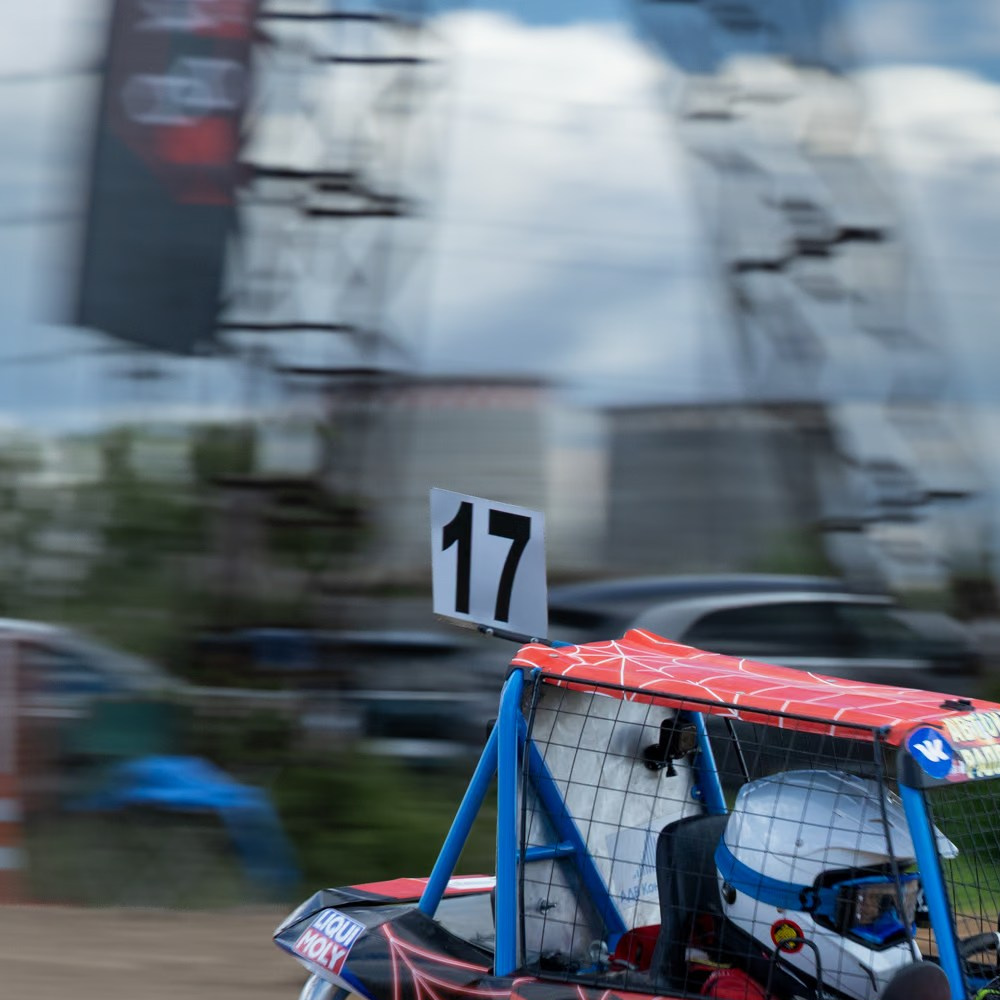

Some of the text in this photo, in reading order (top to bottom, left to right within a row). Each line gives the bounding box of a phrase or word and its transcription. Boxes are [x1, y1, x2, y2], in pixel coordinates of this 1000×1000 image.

[442, 500, 532, 623] 17
[312, 910, 361, 946] LIQUI
[295, 929, 346, 970] MOLY
